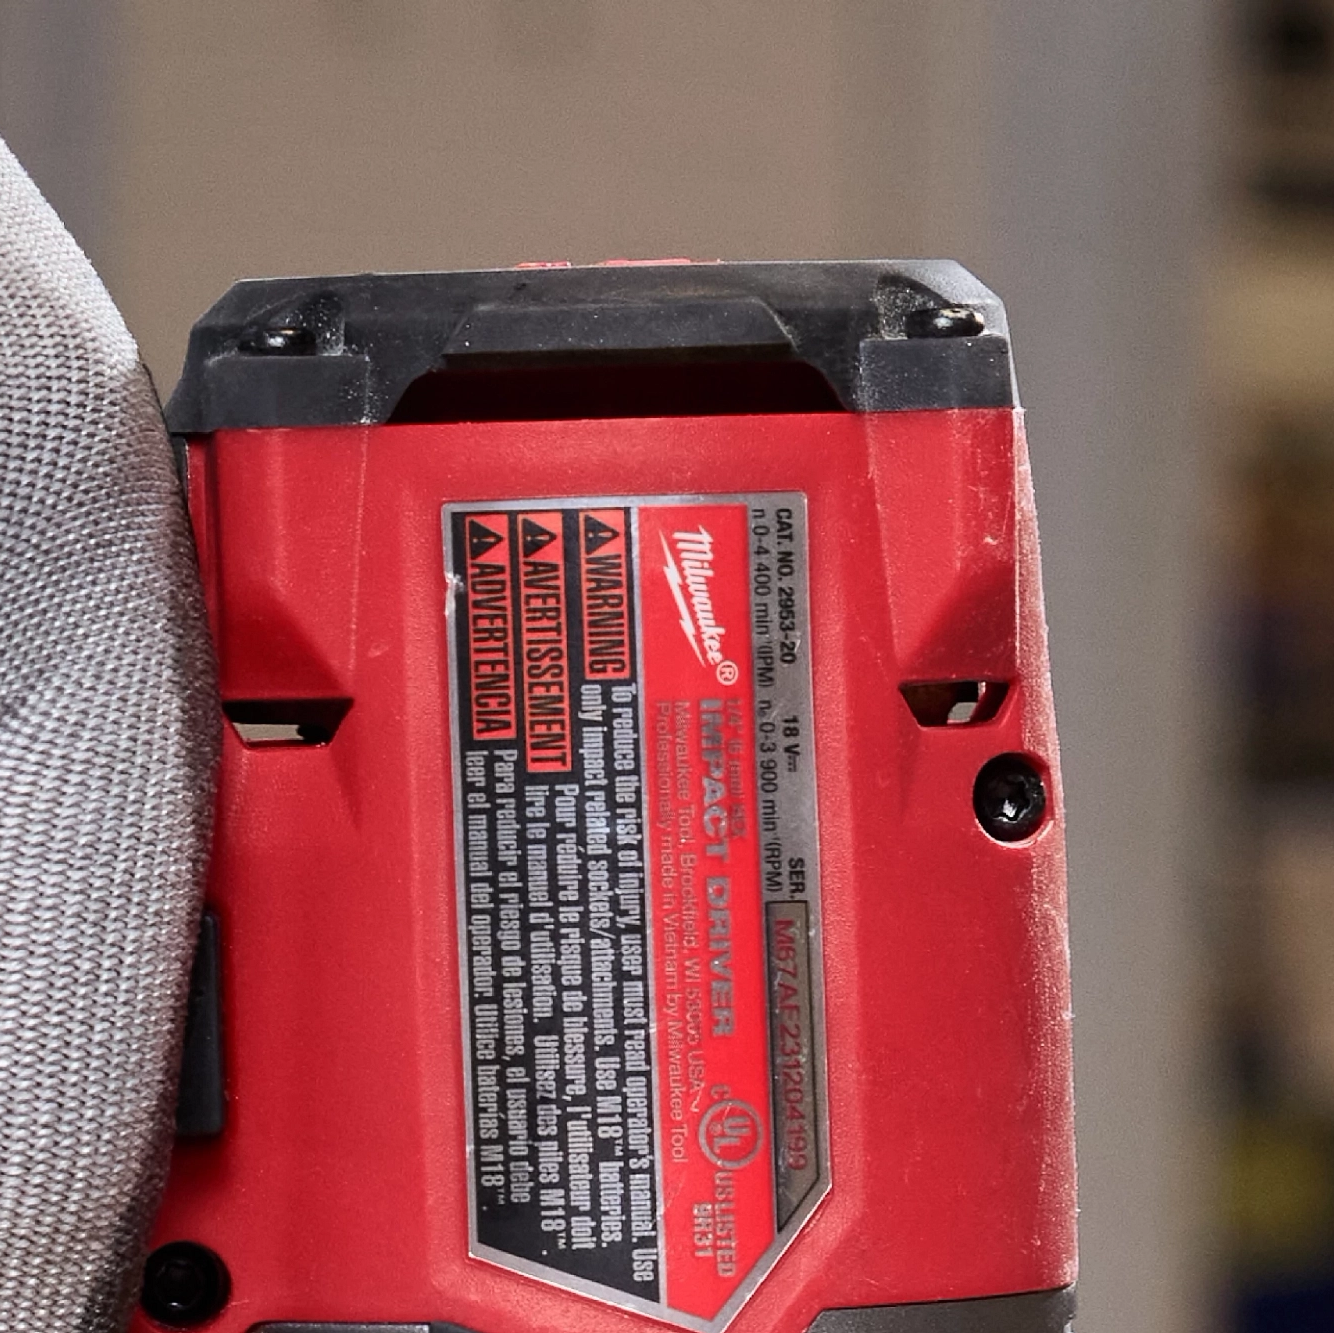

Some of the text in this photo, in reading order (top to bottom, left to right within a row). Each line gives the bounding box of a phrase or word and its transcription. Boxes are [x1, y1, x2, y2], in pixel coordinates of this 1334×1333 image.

[753, 508, 766, 519] n
[753, 525, 771, 555] 0-4
[776, 508, 793, 544] CAT.
[755, 562, 773, 596] 400
[777, 551, 795, 580] NO.
[585, 554, 626, 674] WARNING
[779, 587, 797, 664] 2953-20
[470, 562, 511, 734] ADVERTENCIA
[523, 561, 567, 767] AVERTISSEMENT
[578, 684, 606, 722] only
[783, 716, 799, 737] 18
[579, 726, 609, 787] impact
[674, 701, 694, 799] Milwaukee
[759, 722, 776, 753] 0-3
[465, 751, 489, 787] leer
[761, 759, 778, 793] 900
[466, 793, 491, 808] el
[525, 786, 550, 817] lire
[585, 791, 612, 854] related
[467, 815, 494, 876] manual
[526, 823, 551, 838] le
[469, 883, 494, 908] del
[527, 844, 554, 907] manuel
[700, 699, 735, 1037] IMPACT DRIVER
[789, 858, 805, 899] SER.
[655, 702, 688, 1163] Professionally made in Vietnam by Milwaukee Tool
[679, 854, 699, 953] Brookfield,
[467, 914, 497, 998] operador.
[494, 750, 535, 1202] Para reducir el riesgo de lesiones, el usuario debe
[529, 913, 557, 1023] d'utilisation.
[588, 860, 617, 1051] sockets/attachments.
[611, 683, 658, 1282] To reduce the risk of injury, user must read operator's manual. Use
[685, 958, 699, 982] WI
[474, 1004, 499, 1060] Utilice
[555, 784, 596, 1250] Pour réduire le risque de blessure, l'utilisateur doit
[533, 1036, 561, 1098] Utilisez
[595, 1057, 620, 1090] Use
[687, 1050, 705, 1091] USA
[477, 1066, 505, 1138] baterías
[537, 1104, 563, 1135] des
[533, 1141, 564, 1183] piles
[599, 1161, 625, 1248] batteries.
